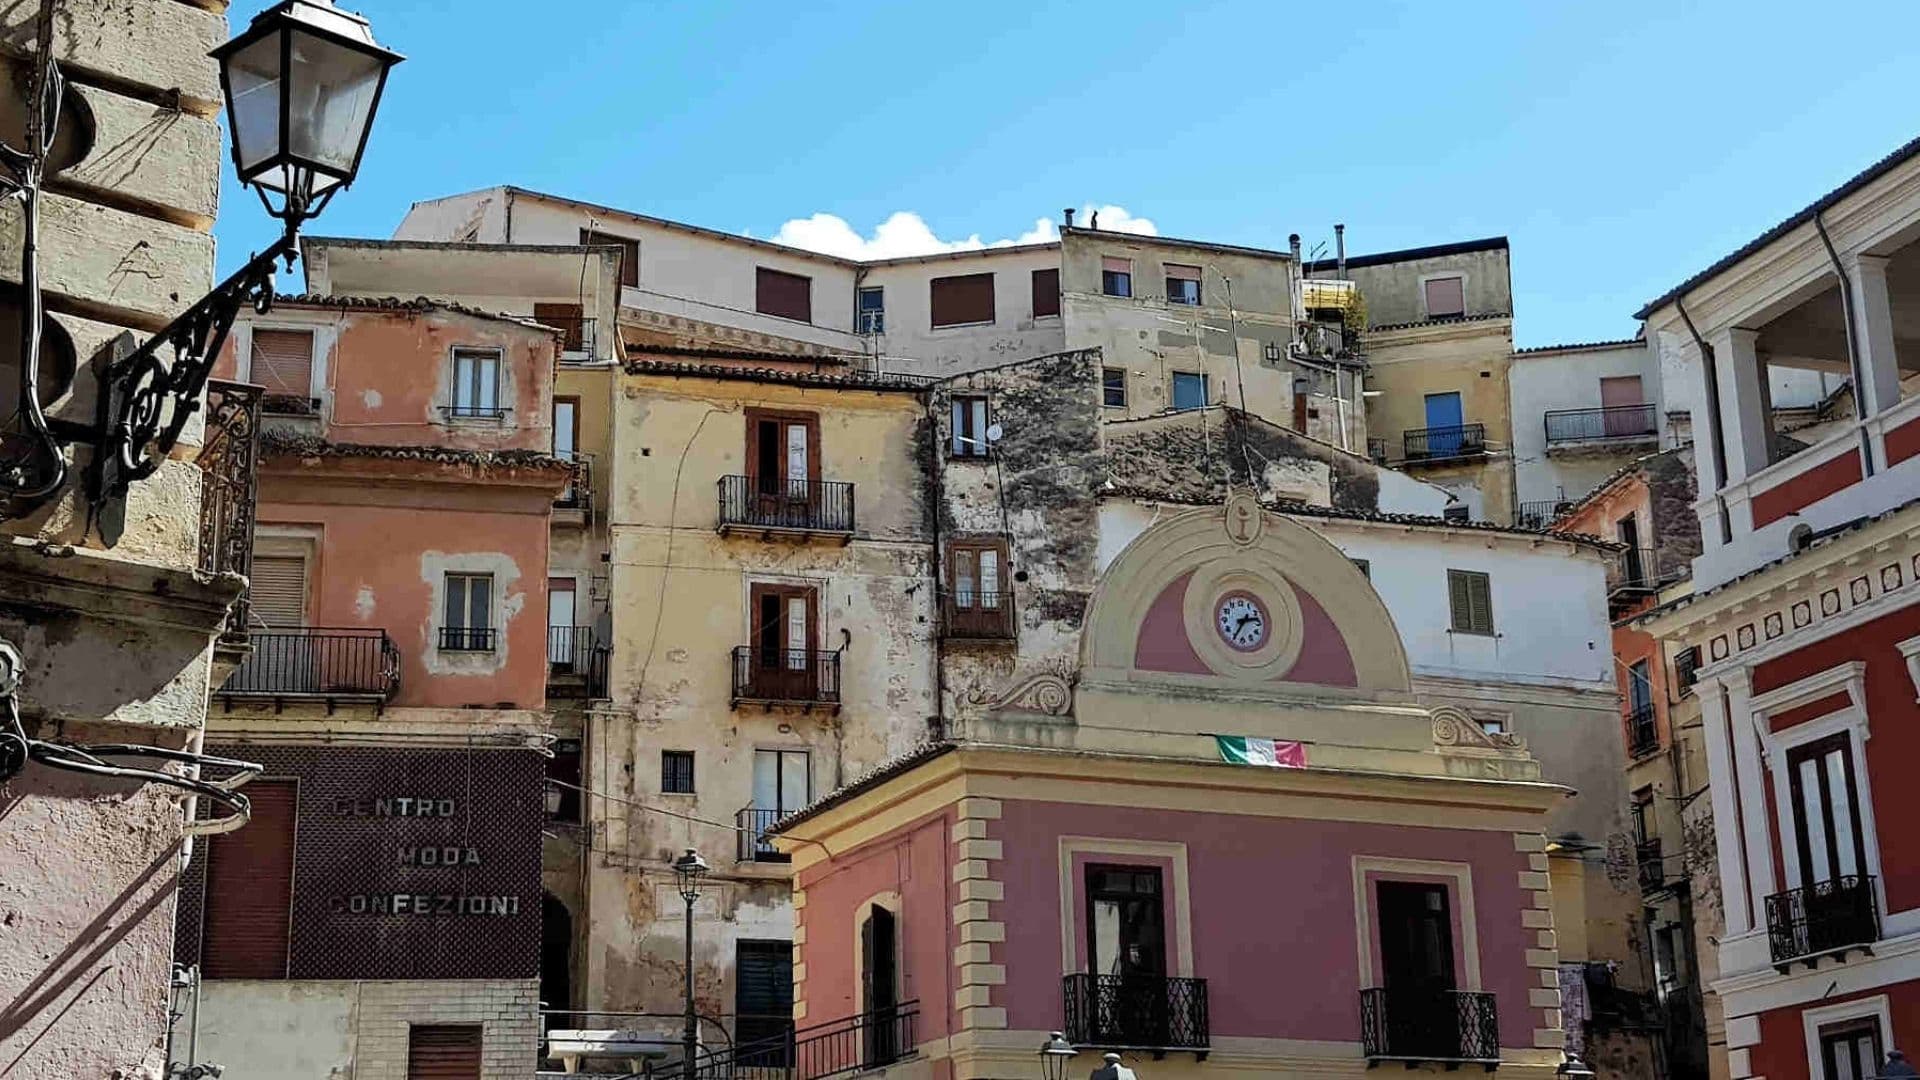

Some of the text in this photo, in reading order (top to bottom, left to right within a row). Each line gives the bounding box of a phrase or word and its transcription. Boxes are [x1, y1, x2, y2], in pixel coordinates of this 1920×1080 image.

[332, 797, 455, 817] CENTRO
[398, 846, 482, 866] MODA
[328, 894, 520, 916] CONFEZIONI
